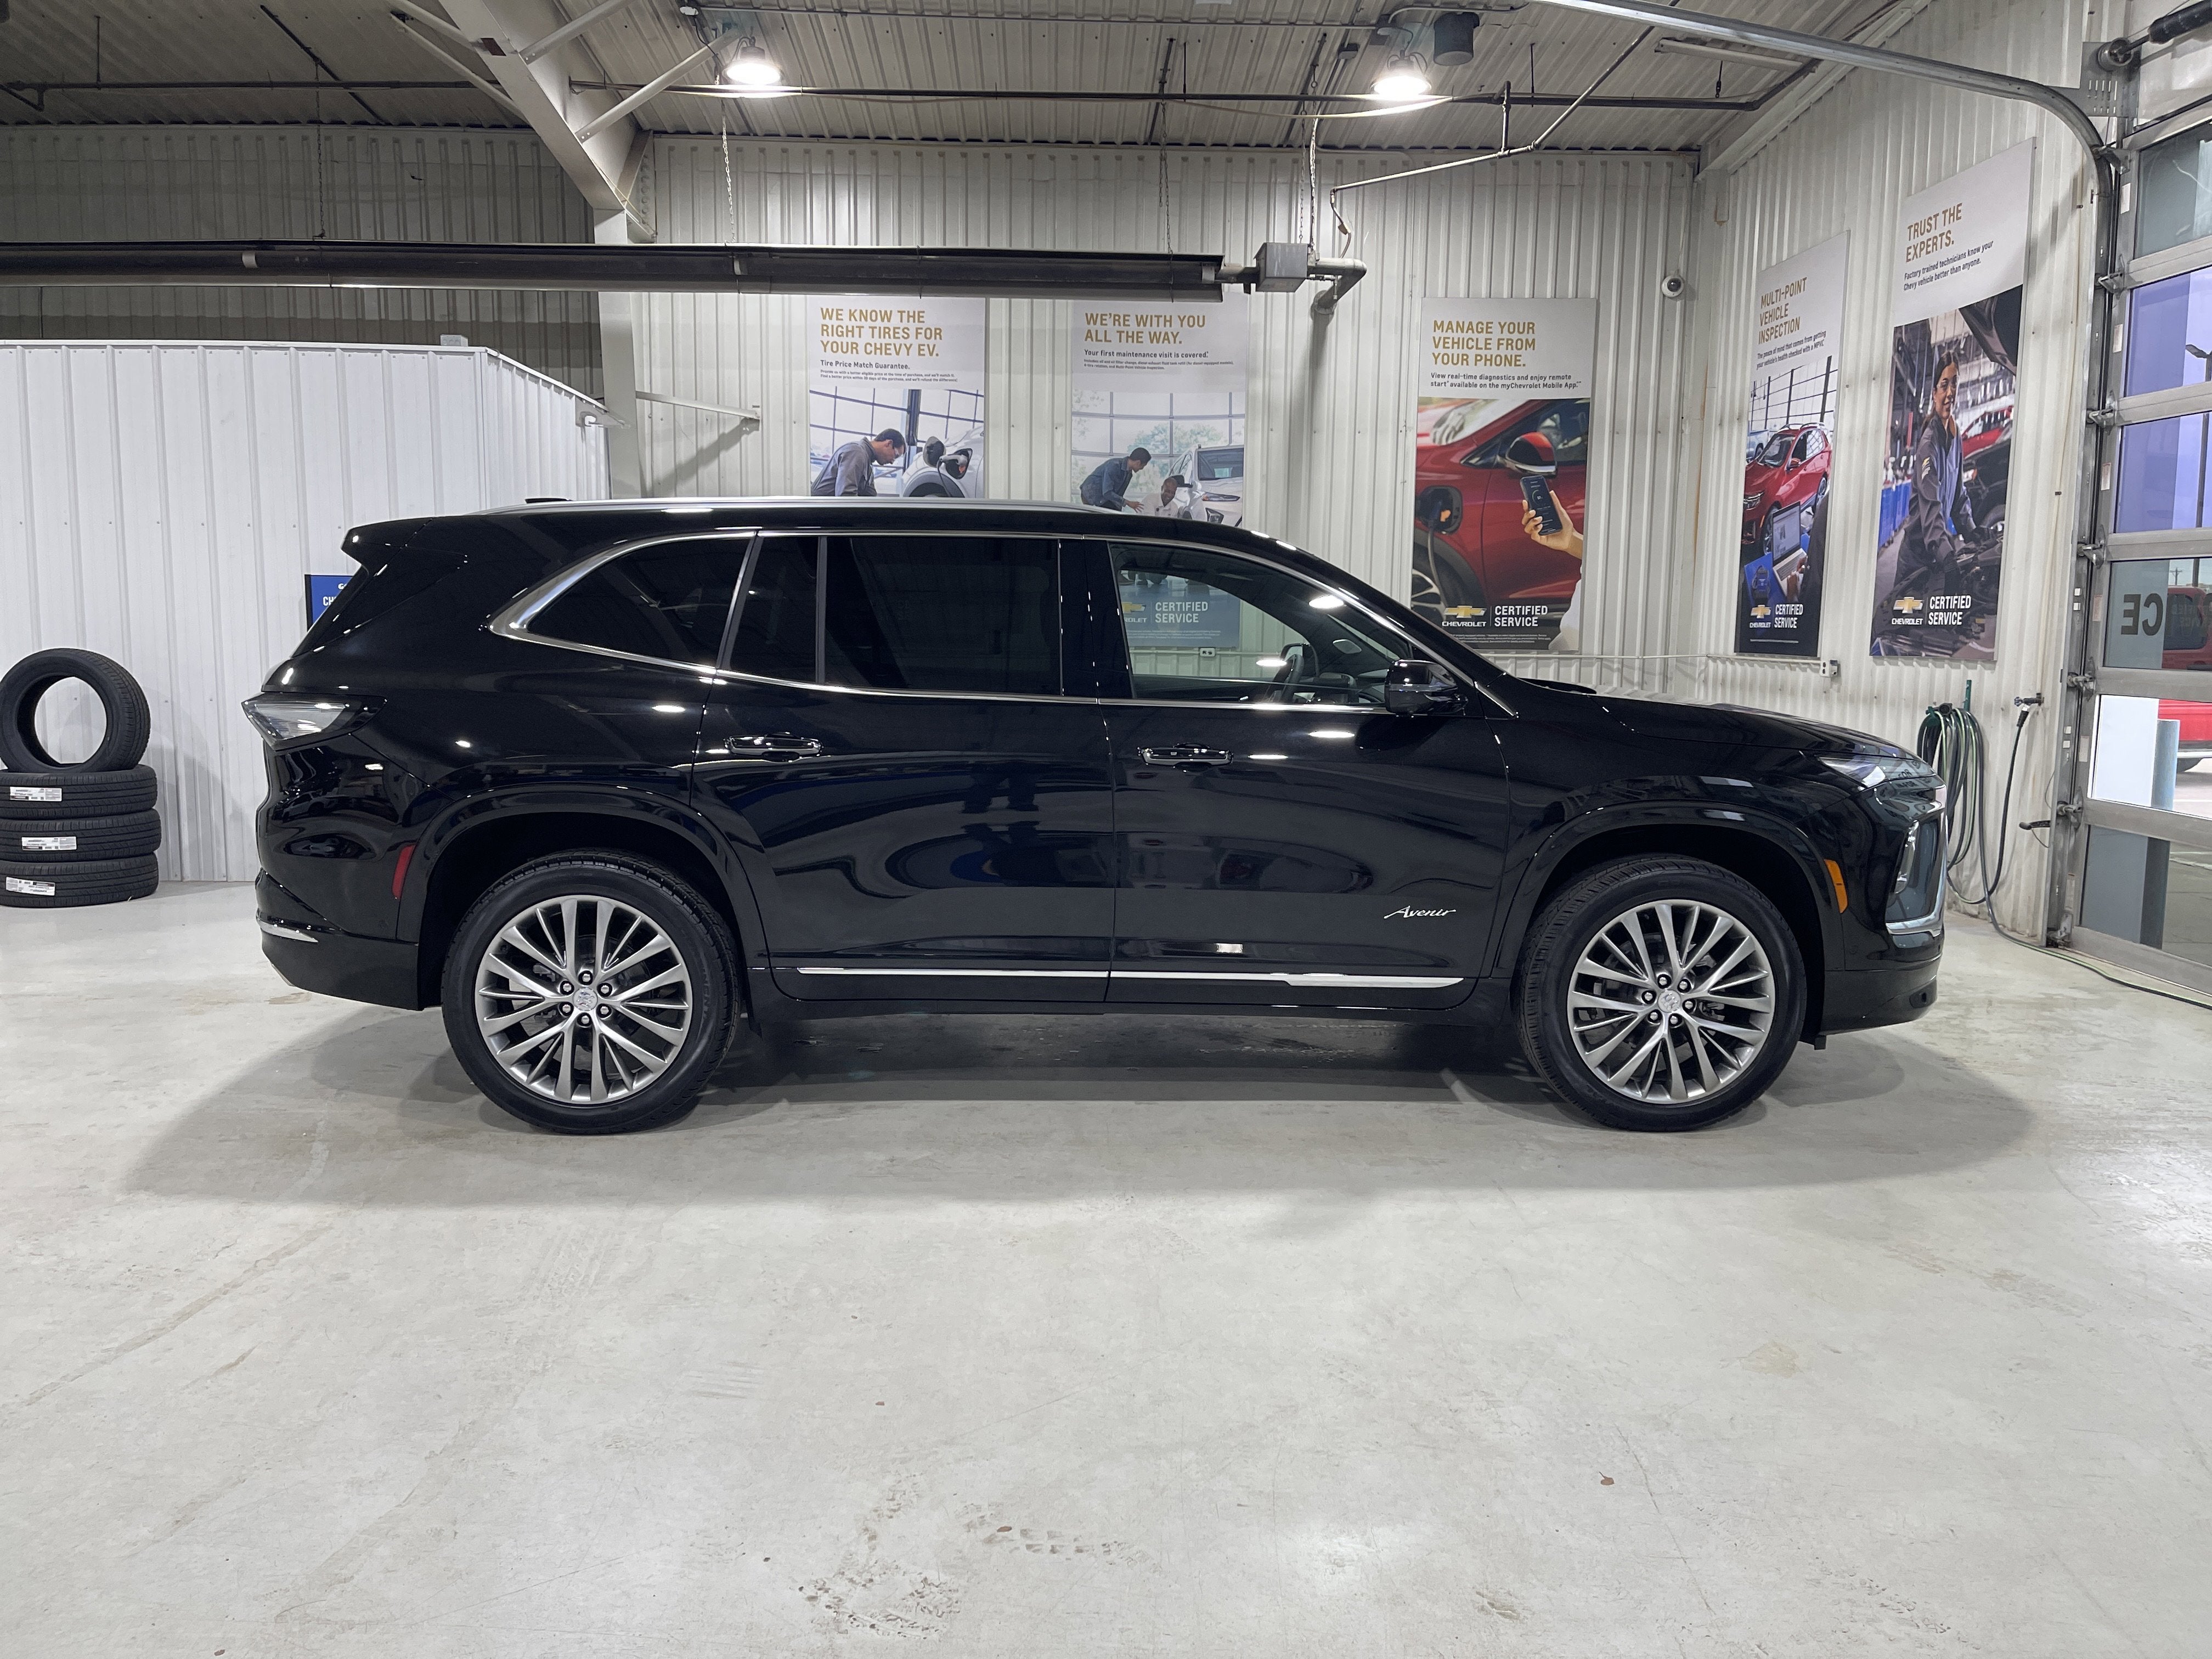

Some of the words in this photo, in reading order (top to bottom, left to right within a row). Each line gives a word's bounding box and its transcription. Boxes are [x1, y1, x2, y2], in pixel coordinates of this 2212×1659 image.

[1908, 213, 1939, 241] TRUST
[1942, 203, 1962, 227] THE
[1906, 230, 1954, 262] EXPERTS.
[1904, 269, 1921, 280] Factory
[1922, 261, 1938, 274] trained
[1940, 252, 1966, 267] technicians
[1968, 247, 1980, 257] know
[1982, 241, 1993, 253] your
[1904, 281, 1917, 290] Chevy
[1918, 275, 1933, 286] vehicle
[1934, 270, 1949, 280] better
[1950, 266, 1961, 274] than
[1962, 258, 1981, 270] anyone.
[1760, 277, 1807, 309] MULTI-POINT
[820, 307, 843, 321] WE
[849, 309, 893, 323] KNOW
[898, 311, 925, 323] THE
[1085, 313, 1130, 327] WE'RE
[1135, 314, 1172, 328] WITH
[1177, 315, 1206, 328] YOU
[1760, 303, 1789, 326] VEHICLE
[821, 324, 864, 338] RIGHT
[869, 326, 910, 340] TIRES
[915, 327, 943, 341] FOR
[1433, 320, 1493, 334] MANAGE
[1498, 321, 1536, 335] YOUR
[1758, 317, 1800, 345] INSPECTION
[1084, 329, 1112, 343] ALL
[1116, 330, 1144, 343] THE
[1148, 331, 1182, 345] WAY.
[1432, 336, 1492, 350] VEHICLE
[1497, 338, 1536, 351] FROM
[820, 340, 859, 355] YOUR
[864, 342, 913, 356] CHEVY
[918, 343, 939, 357] EV.
[1432, 352, 1469, 366] YOUR
[1474, 354, 1526, 367] PHONE.
[1479, 374, 1515, 382] diagnostics
[323, 596, 337, 606] CH
[1155, 602, 1209, 612] CERTIFIED
[1929, 595, 1971, 610] CERTIFIED
[1494, 605, 1548, 616] CERTIFIED
[1775, 604, 1803, 615] CERTIFIED
[1155, 613, 1199, 623] SERVICE
[1494, 617, 1538, 627] SERVICE
[1774, 617, 1798, 628] SERVICE
[1928, 612, 1963, 625] SERVICE
[1384, 905, 1457, 919] Avenir
